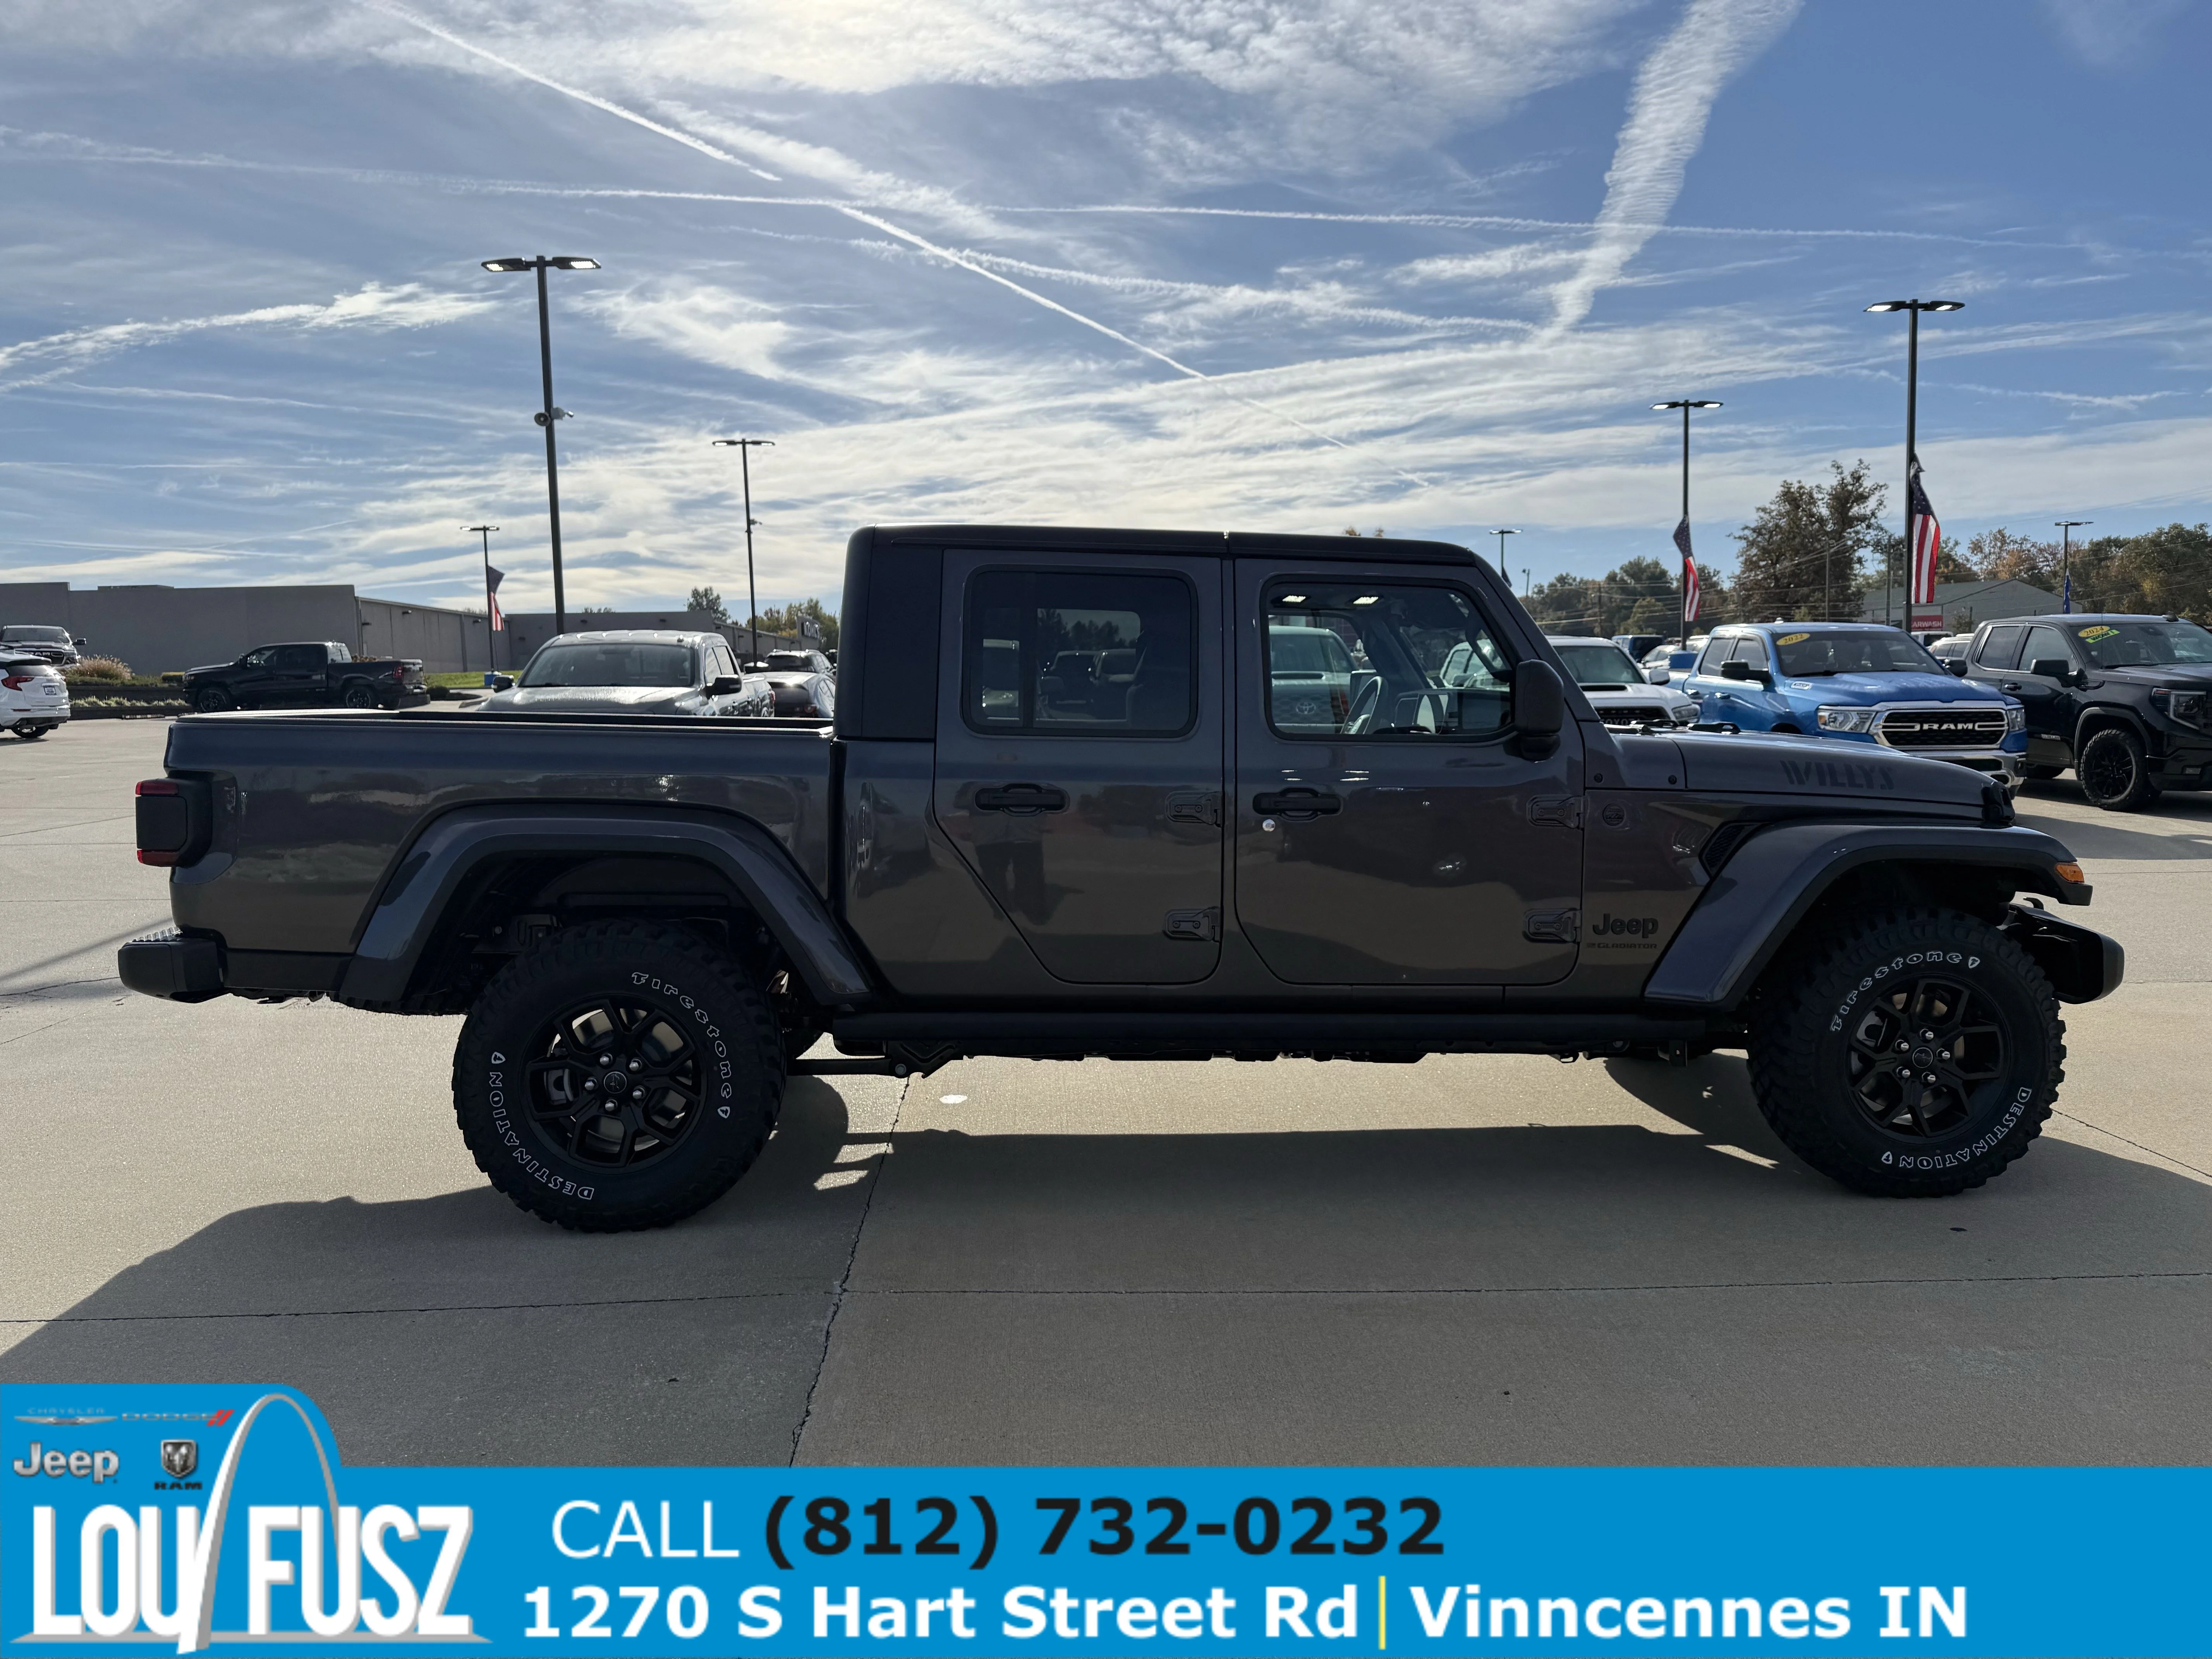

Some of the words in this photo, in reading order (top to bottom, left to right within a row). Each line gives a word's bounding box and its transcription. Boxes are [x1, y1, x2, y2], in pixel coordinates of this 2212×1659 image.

[1780, 760, 1894, 790] WILLYS
[1592, 913, 1659, 938] Jeep
[489, 1072, 595, 1200] DESTINATION
[1899, 1087, 2032, 1170] DESTINATION
